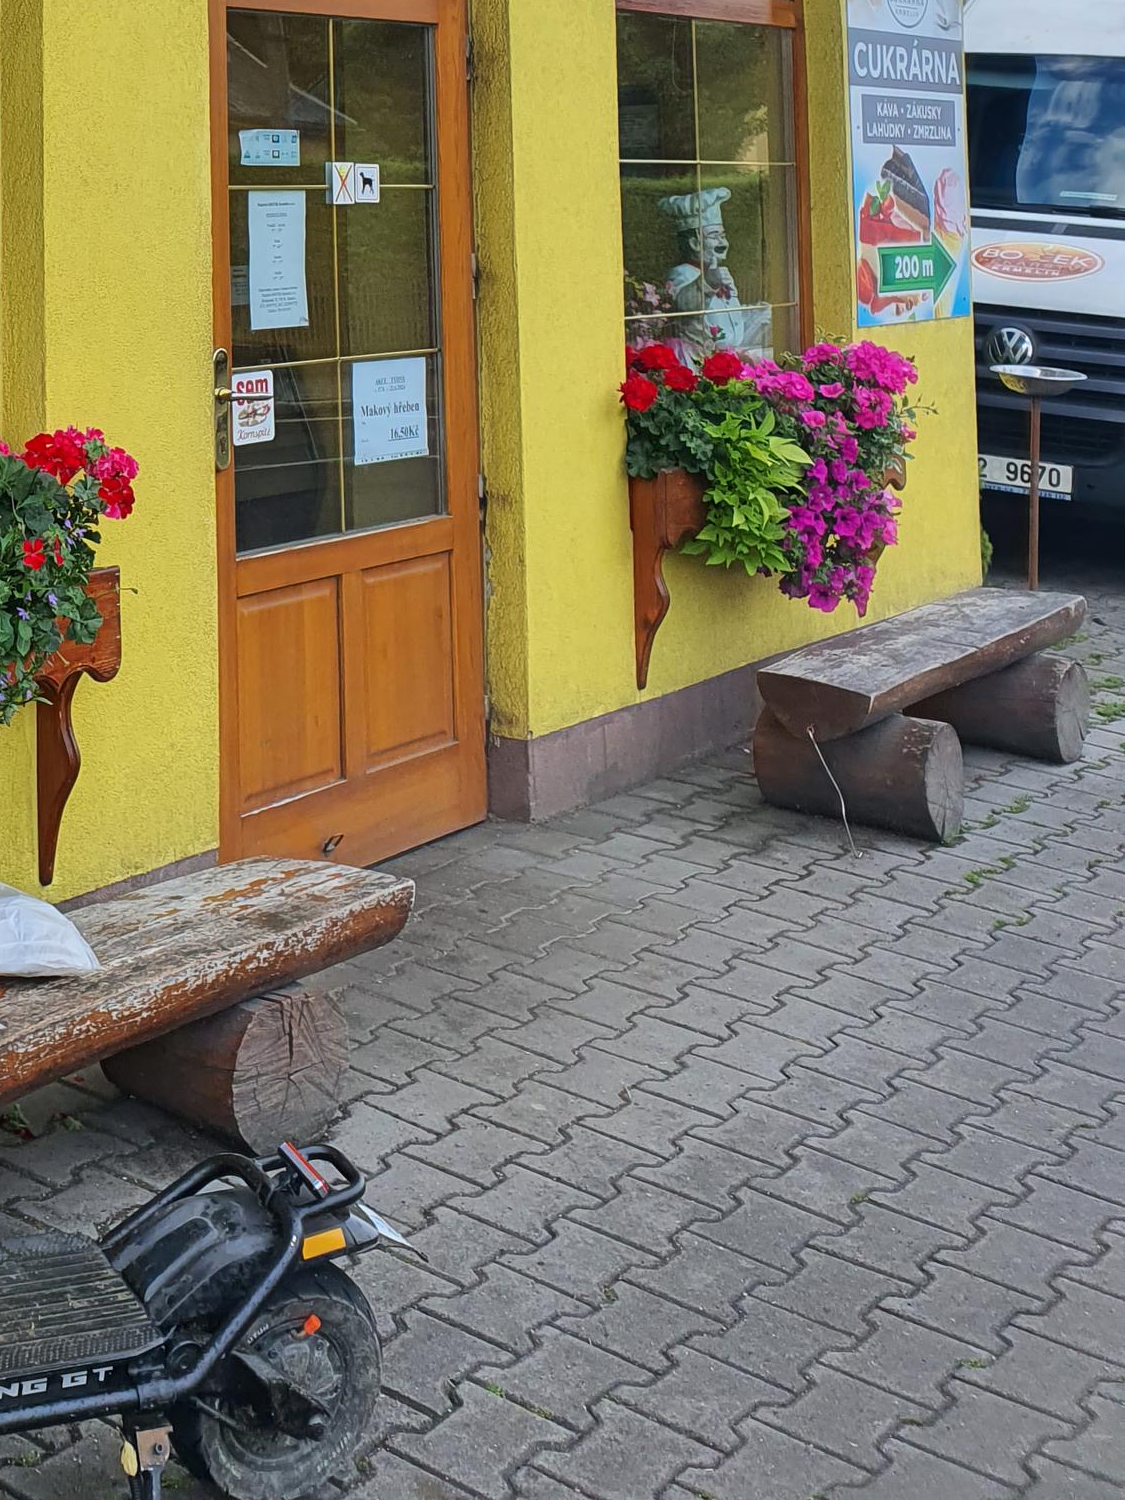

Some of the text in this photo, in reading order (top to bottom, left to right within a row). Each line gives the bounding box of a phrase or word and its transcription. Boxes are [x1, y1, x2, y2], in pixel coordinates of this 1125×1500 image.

[853, 39, 961, 85] CUKRÁRNA
[877, 99, 942, 121] KÁVA ZÁKUSKY
[866, 118, 952, 141] LAHŮDKY ZMRZLINA
[895, 255, 934, 279] 200 m
[360, 401, 421, 418] Makový hřeben
[1005, 461, 1061, 488] 9670
[61, 1365, 114, 1389] GT
